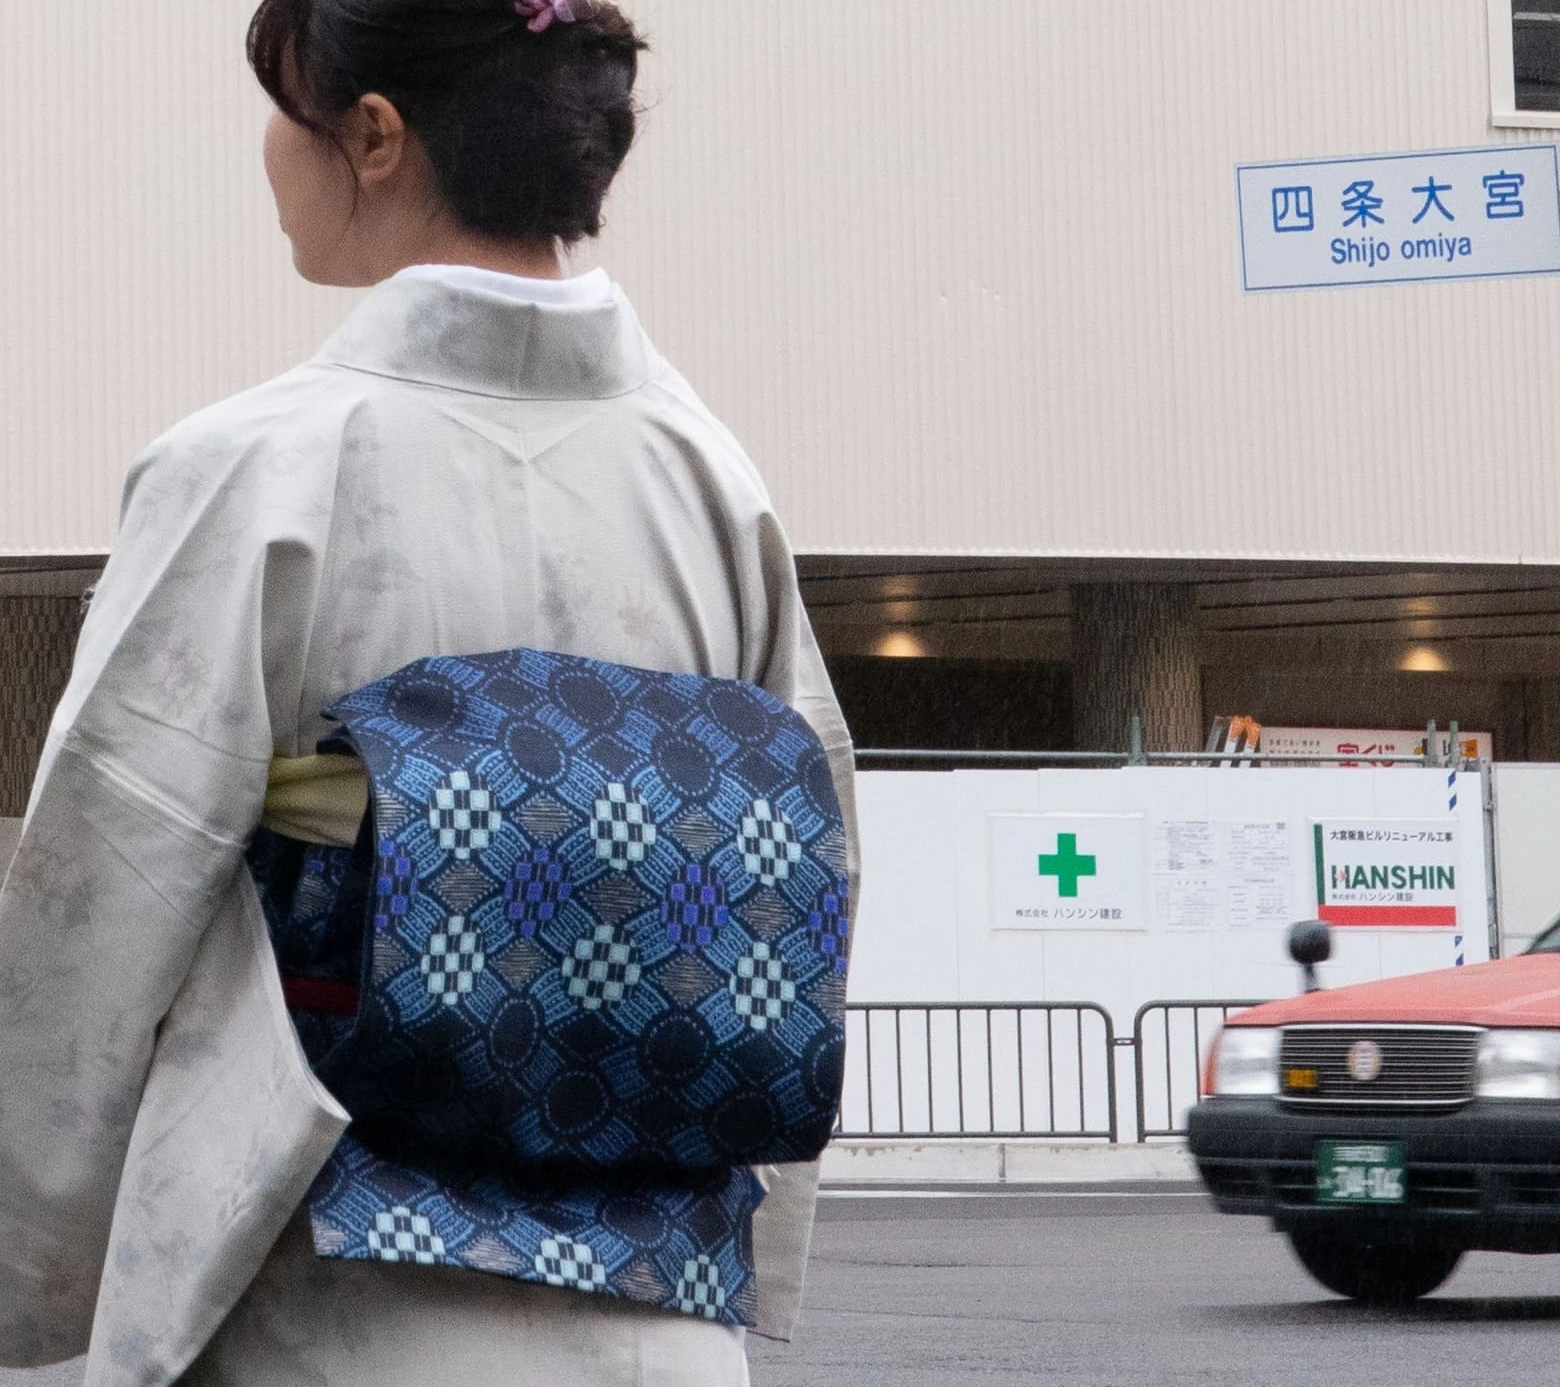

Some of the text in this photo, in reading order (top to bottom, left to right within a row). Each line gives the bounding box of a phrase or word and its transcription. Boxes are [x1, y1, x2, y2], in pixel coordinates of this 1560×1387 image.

[1271, 169, 1526, 233] 四条大宮
[1330, 232, 1473, 268] Shijo omiya
[1330, 829, 1454, 843] 大宮阪急ビルリニューアル工事
[1330, 864, 1456, 890] HANSHIN
[1053, 908, 1123, 919] ハンシン建設
